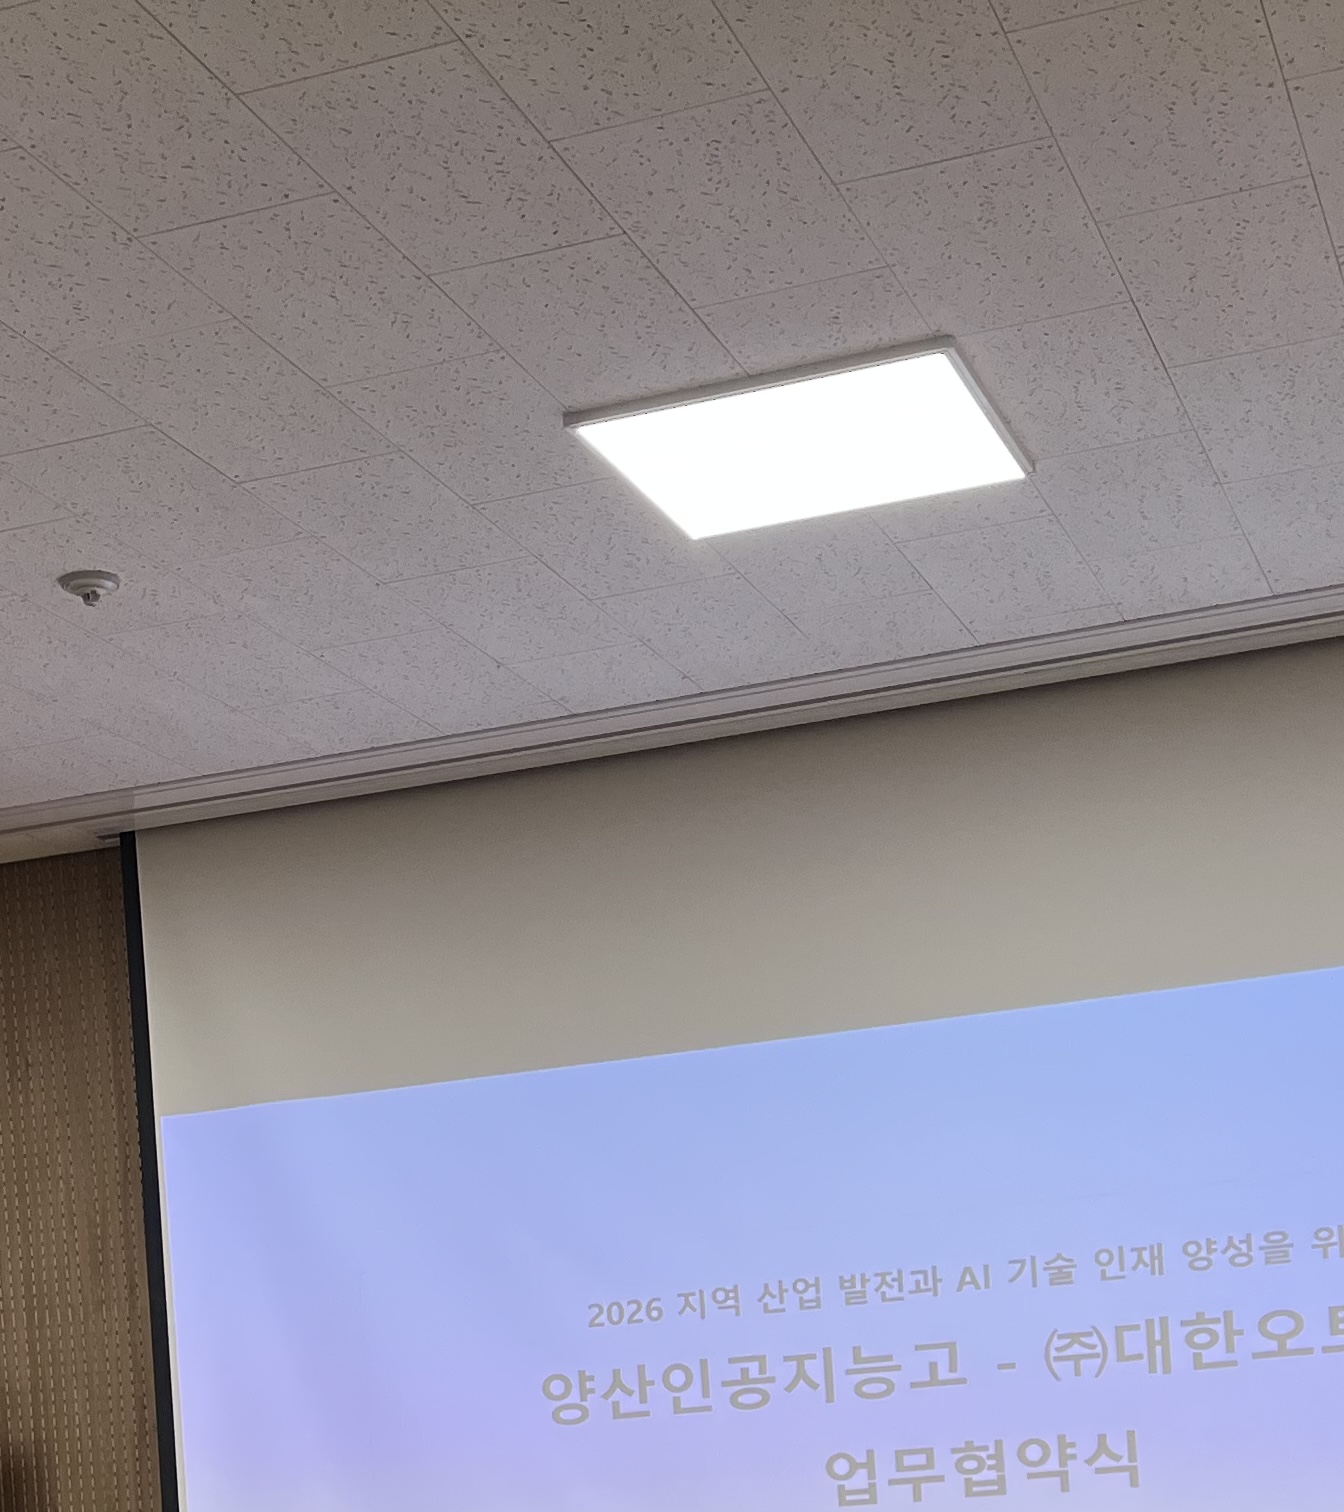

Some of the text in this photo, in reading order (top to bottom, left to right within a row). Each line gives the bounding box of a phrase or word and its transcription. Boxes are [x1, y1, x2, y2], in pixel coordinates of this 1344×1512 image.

[587, 1298, 664, 1328] 2026
[677, 1284, 742, 1320] 지역
[757, 1276, 823, 1314] 산업
[837, 1265, 943, 1306] 발전과
[957, 1264, 991, 1293] AI
[1008, 1252, 1078, 1288] 기술
[1093, 1242, 1166, 1282] 인재
[1181, 1229, 1295, 1272] 양성을
[541, 1340, 968, 1426] 양산인공지능고
[825, 1429, 1140, 1508] 업무협약식
